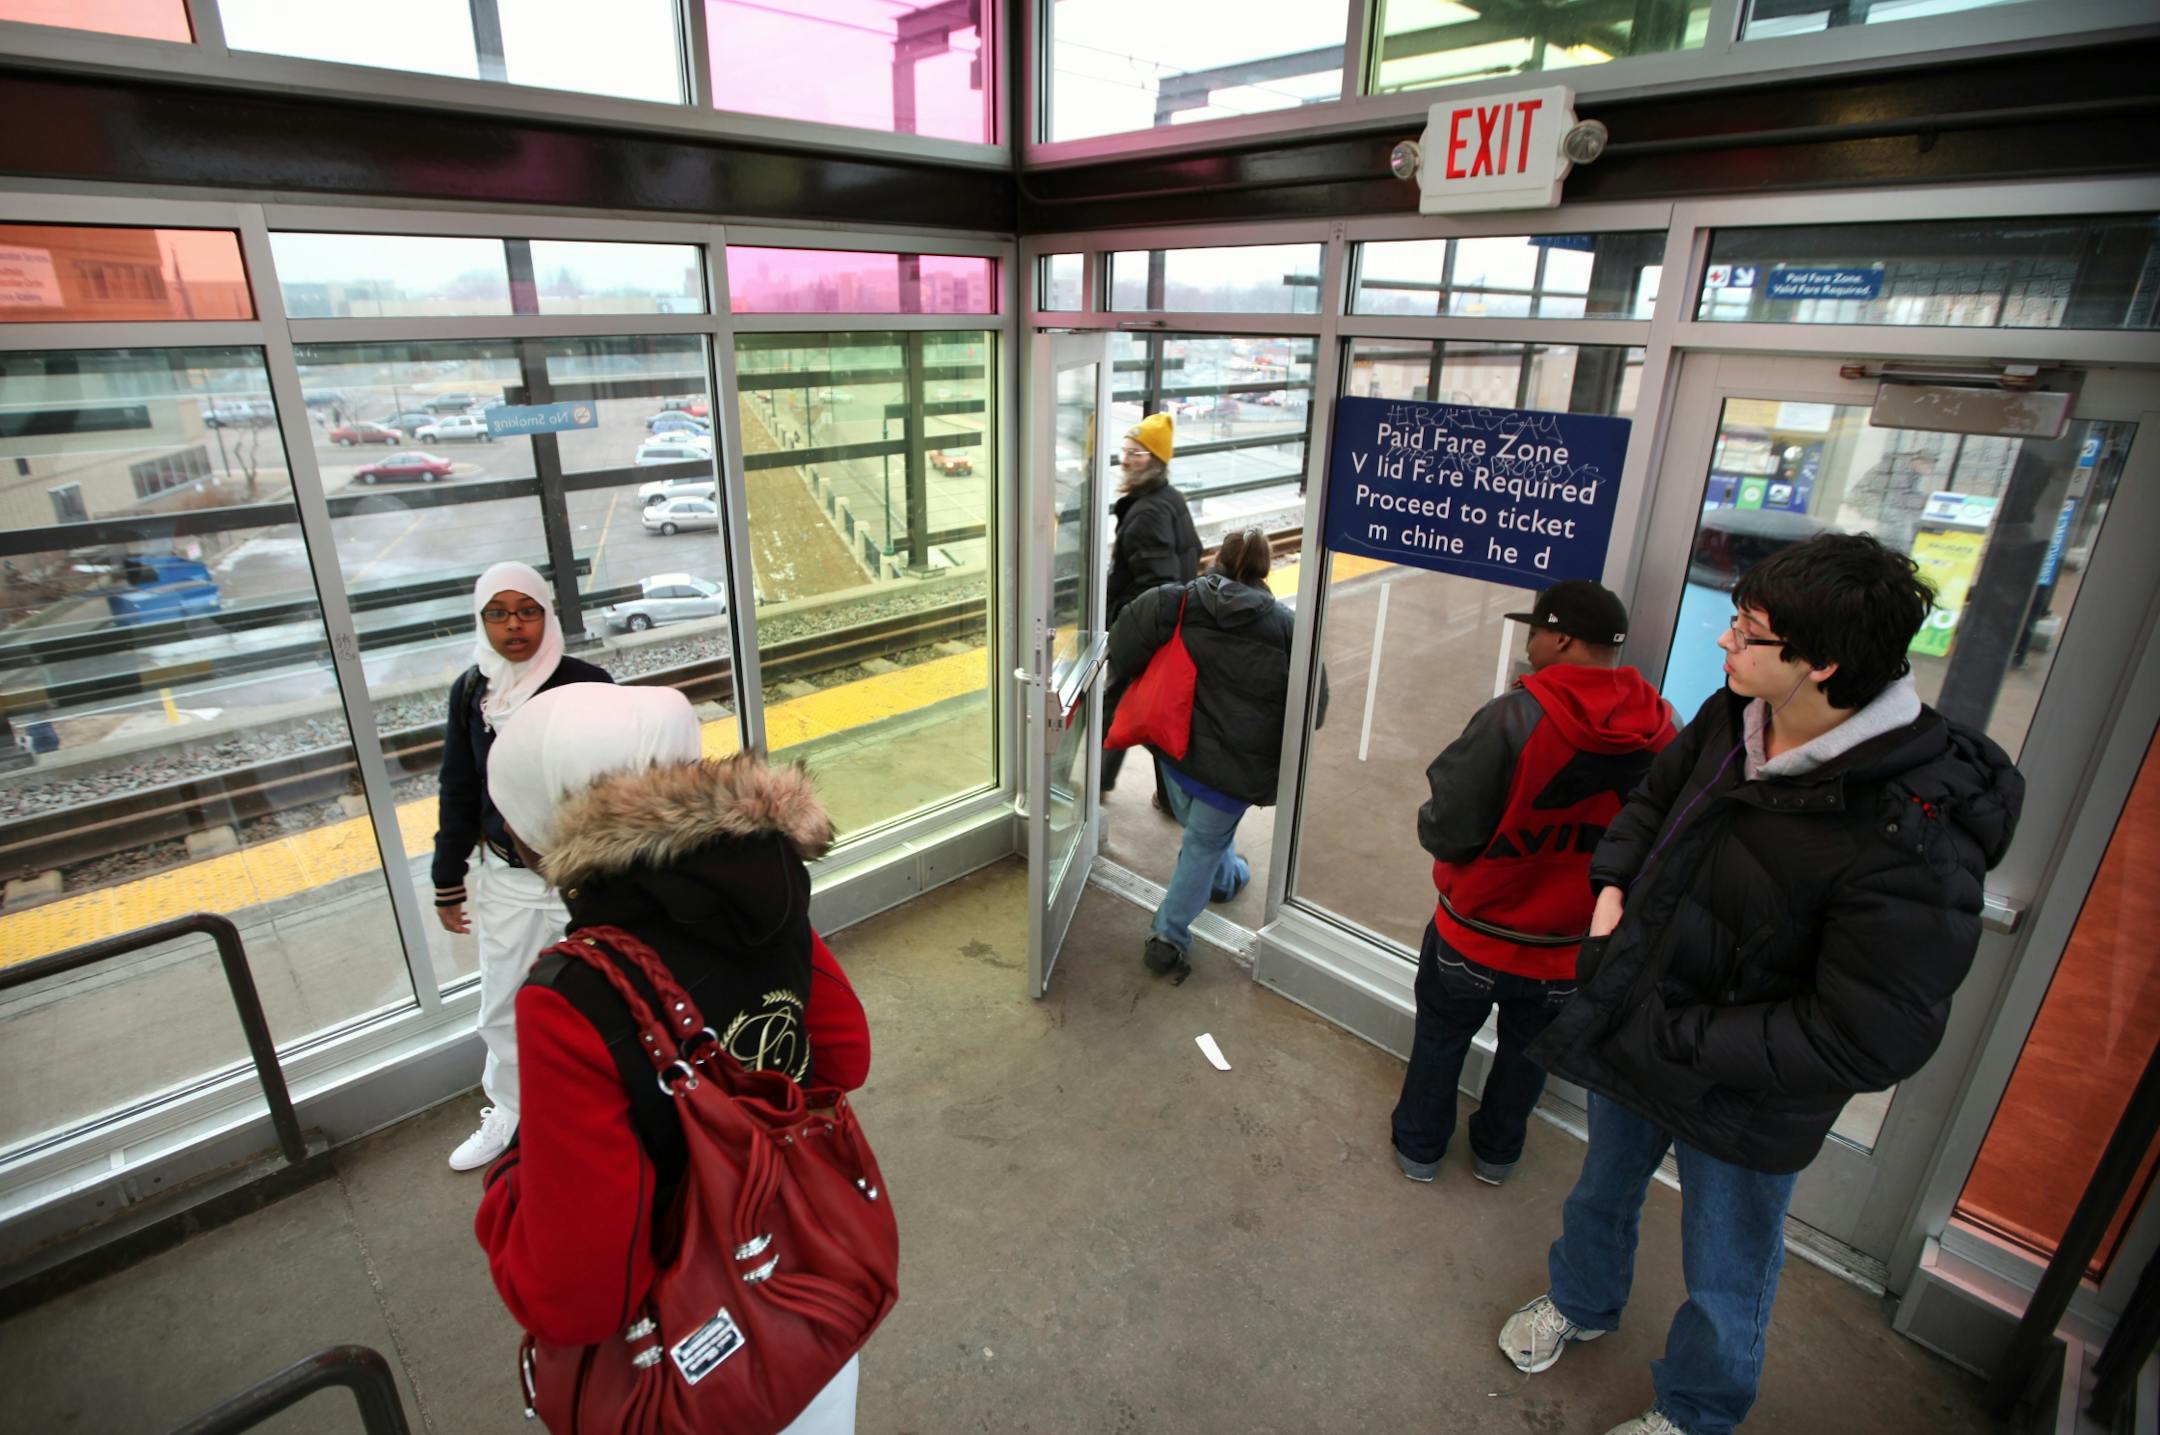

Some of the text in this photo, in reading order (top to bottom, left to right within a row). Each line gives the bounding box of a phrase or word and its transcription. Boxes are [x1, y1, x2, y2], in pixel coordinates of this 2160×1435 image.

[1445, 99, 1542, 180] EXIT
[1774, 284, 1799, 296] Valid
[1798, 284, 1822, 296] Fare
[1785, 272, 1809, 284] Paid
[1809, 273, 1833, 284] Fare
[1377, 422, 1569, 465] Paid Fare Zone
[1352, 452, 1403, 482] Vlid
[1474, 466, 1598, 505] Required
[1356, 484, 1576, 539] Proceed to ticket
[1368, 522, 1464, 554] mchine
